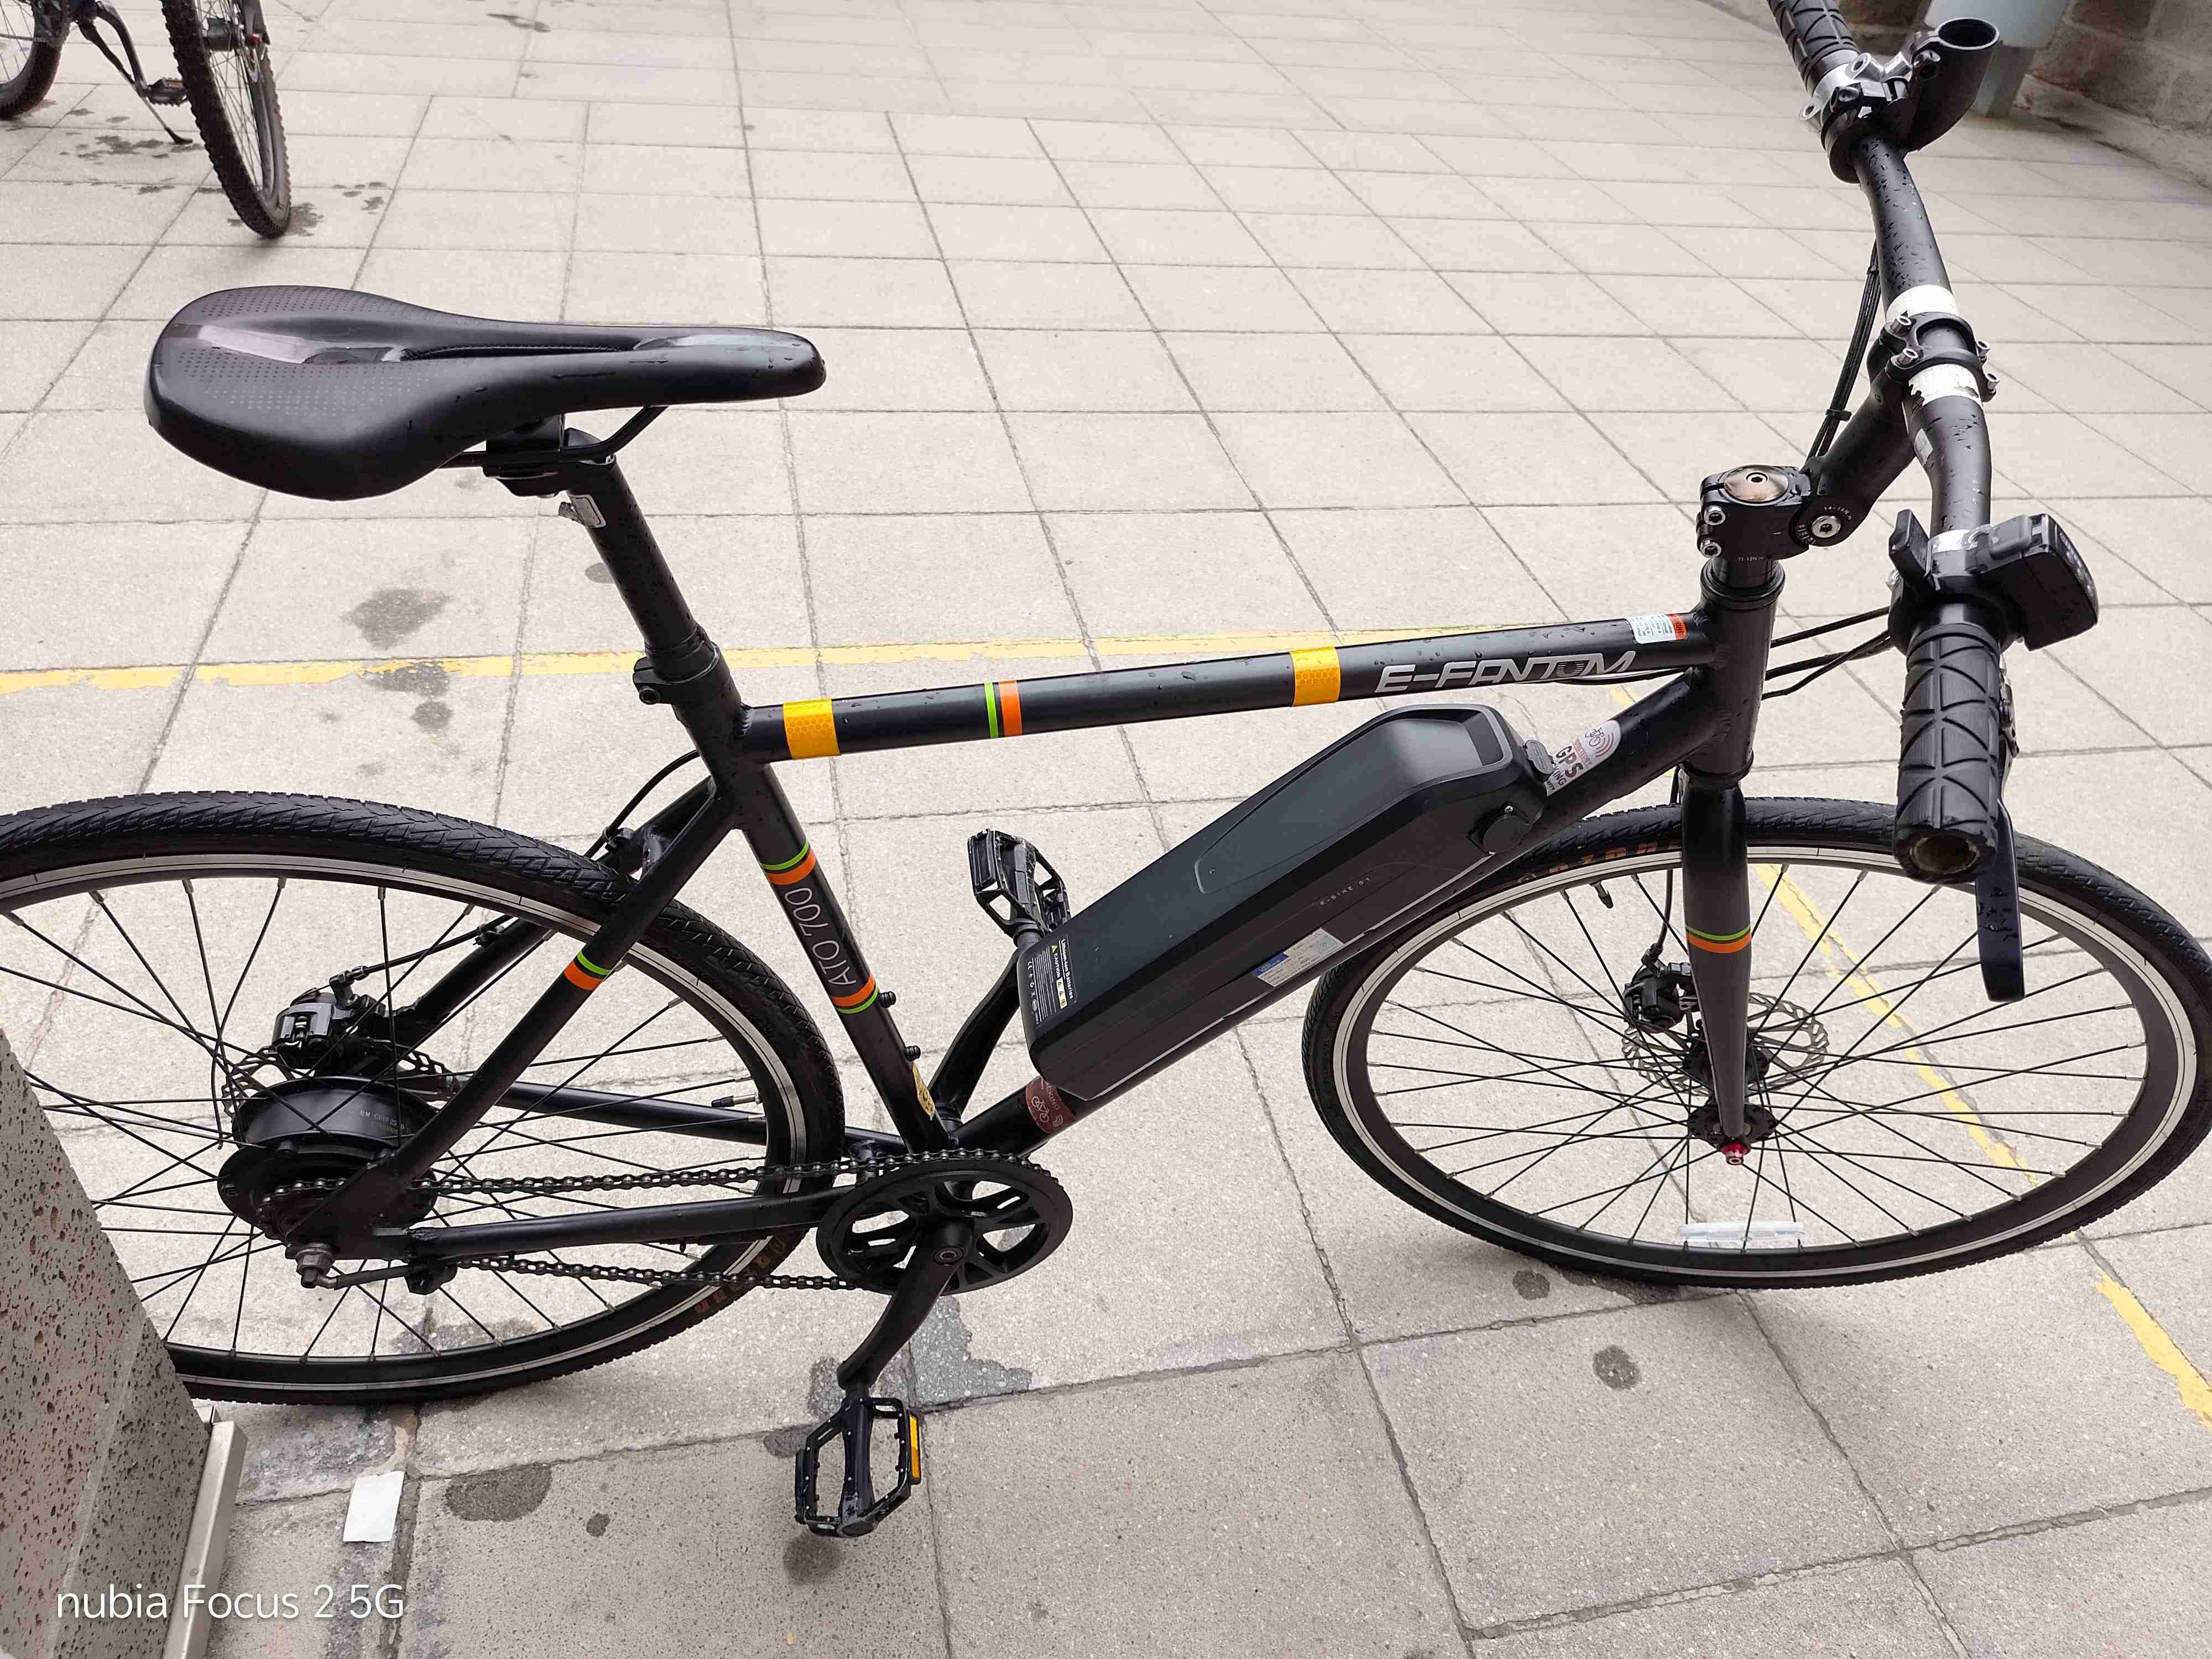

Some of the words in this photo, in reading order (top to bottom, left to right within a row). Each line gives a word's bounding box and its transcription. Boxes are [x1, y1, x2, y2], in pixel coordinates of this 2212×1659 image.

[1375, 651, 1636, 693] E-FANTOM
[1556, 746, 1583, 778] GPS
[785, 888, 829, 936] 700
[812, 940, 857, 985] ATO
